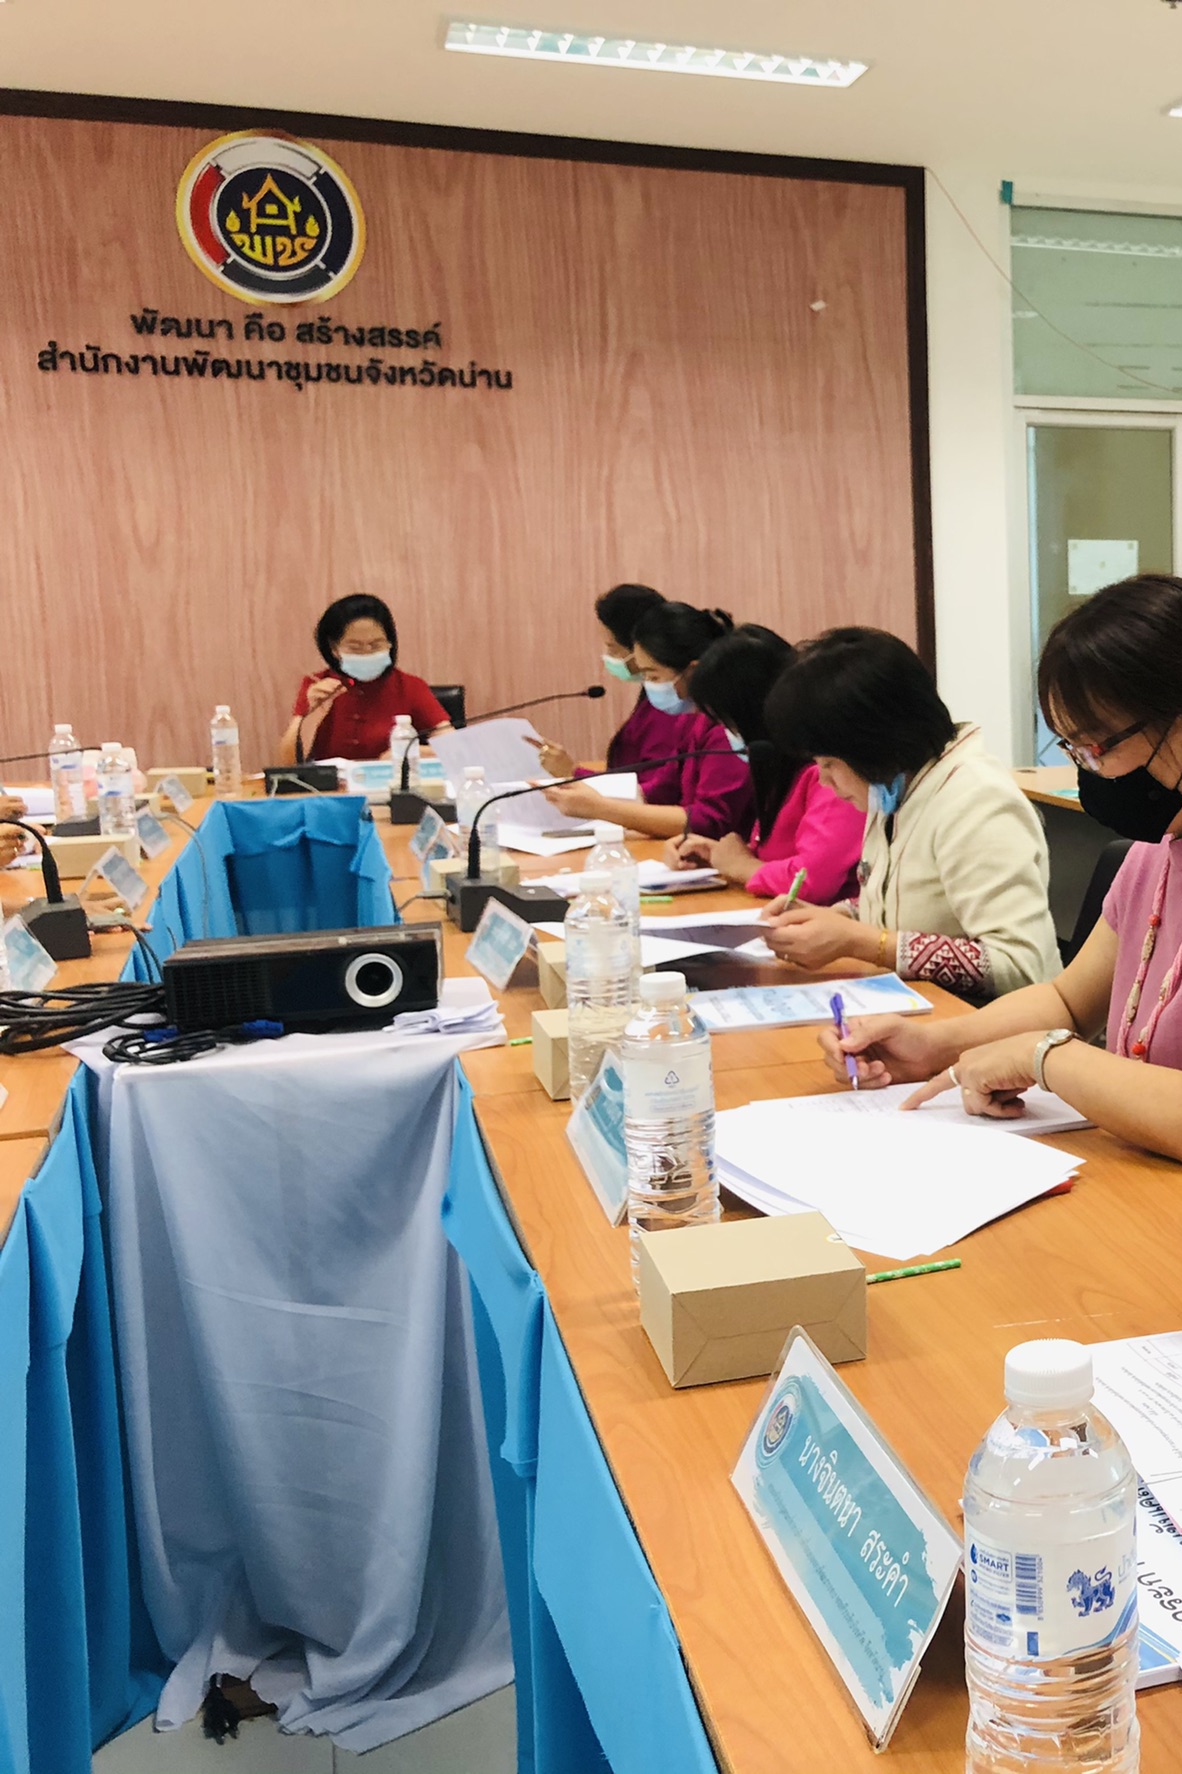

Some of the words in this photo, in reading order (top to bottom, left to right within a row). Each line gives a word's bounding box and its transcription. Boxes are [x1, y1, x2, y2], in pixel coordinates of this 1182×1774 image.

[129, 307, 234, 340] พัฒนา
[244, 312, 286, 342] คือ
[296, 315, 442, 350] สร้างสรรค์
[37, 340, 513, 391] สำนักงานพัฒนาชุมชนจังหวัดน่าน
[798, 1434, 862, 1538] นางจินตนา
[860, 1529, 910, 1608] สระคำ
[979, 1553, 1010, 1572] SMART
